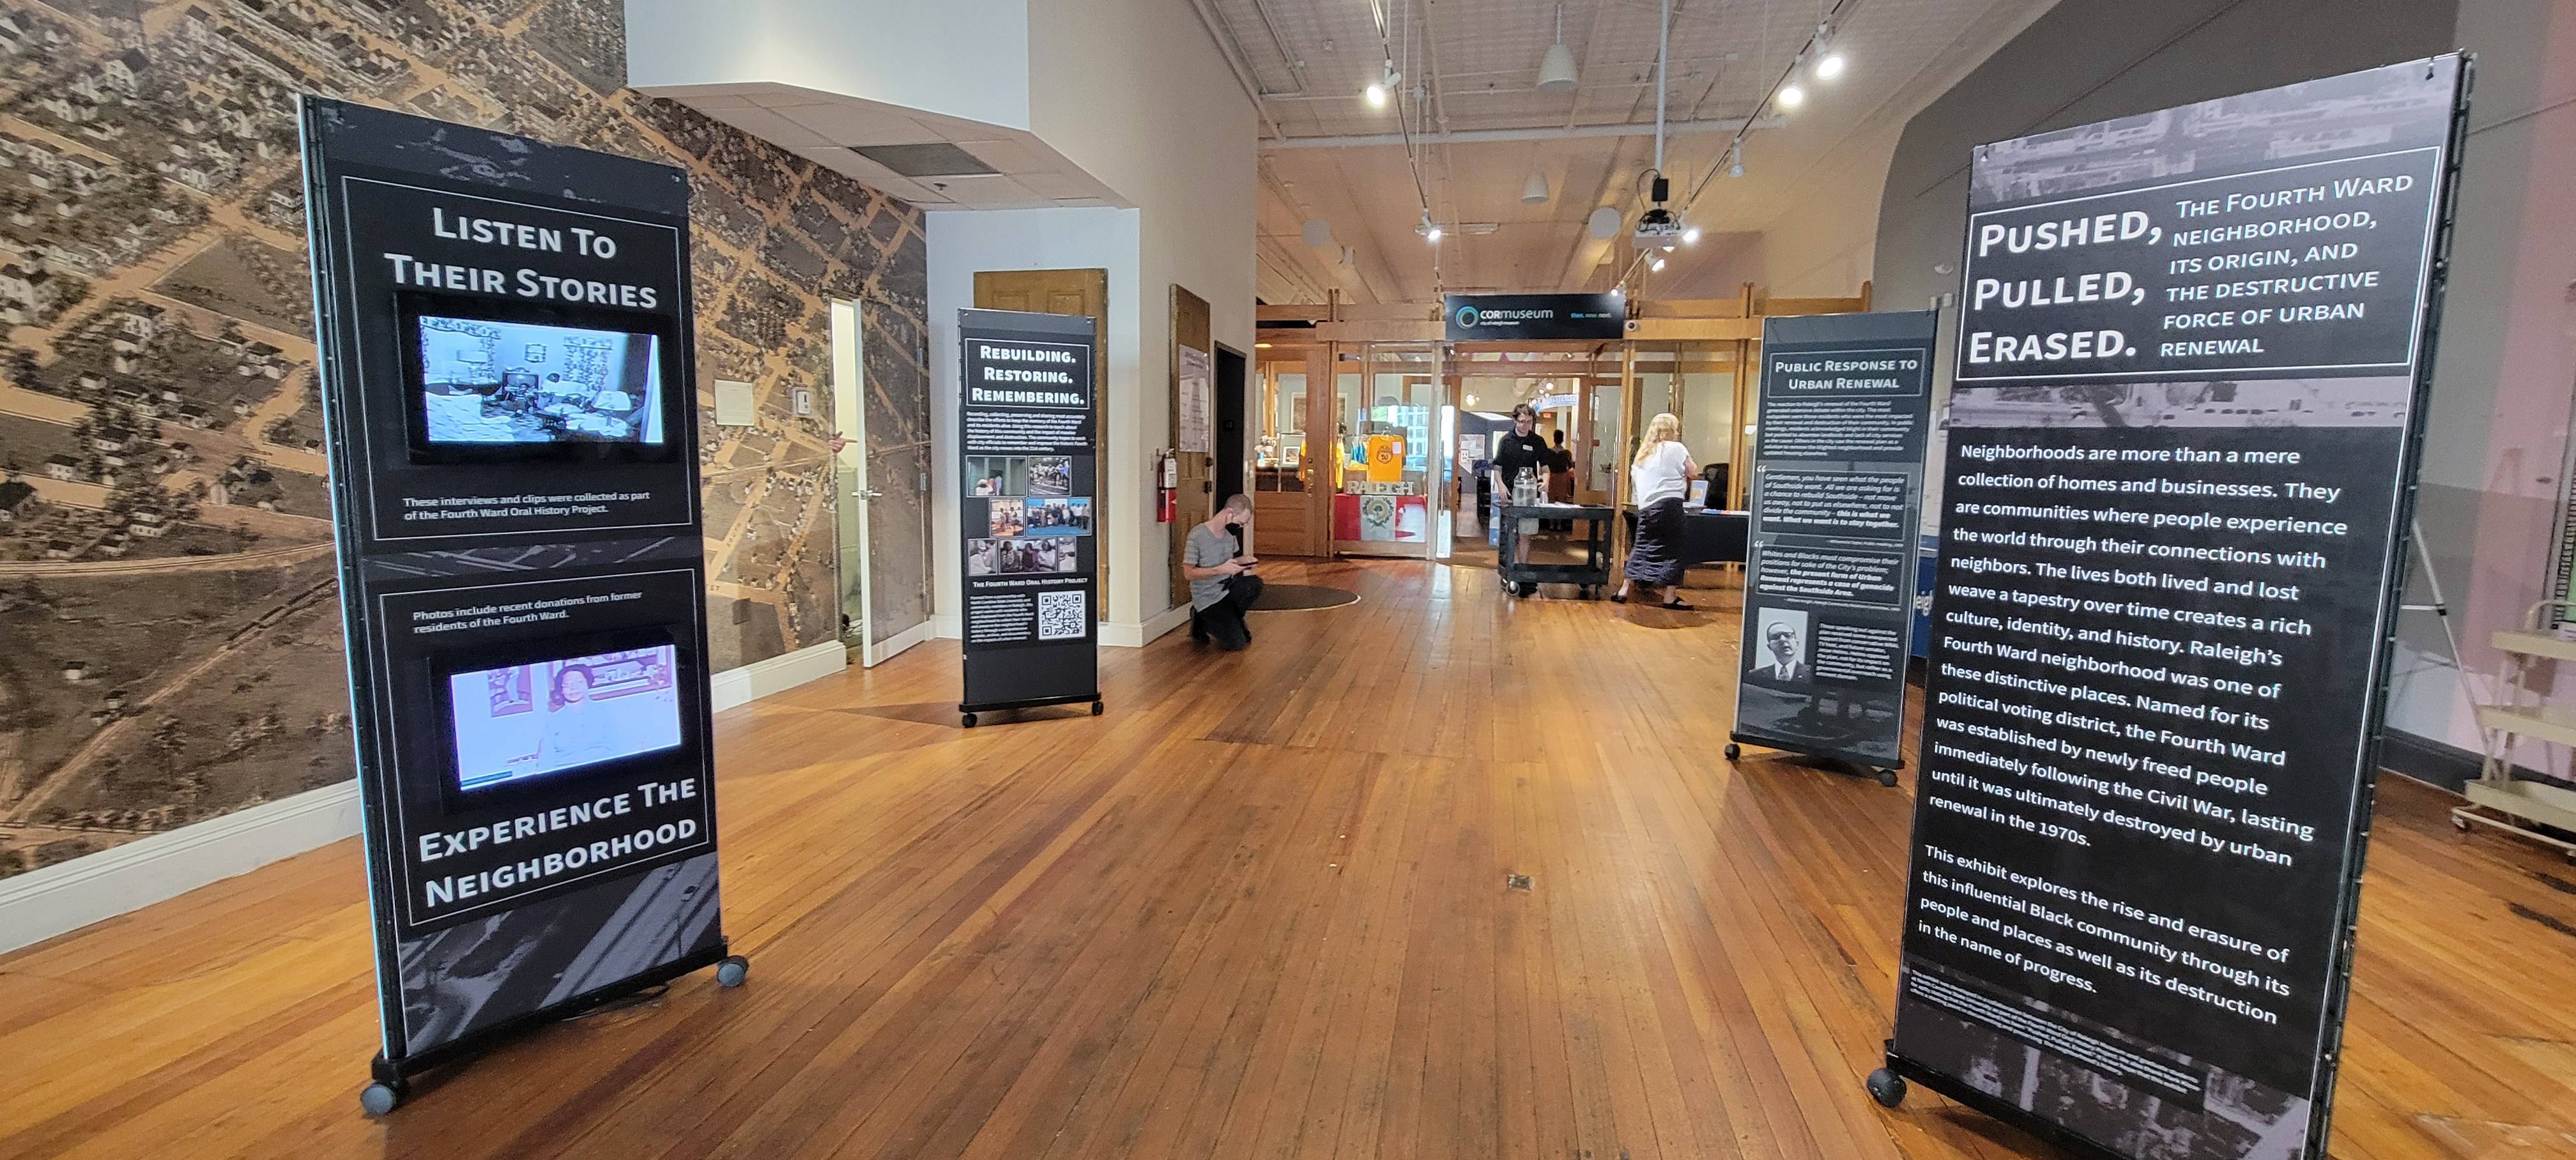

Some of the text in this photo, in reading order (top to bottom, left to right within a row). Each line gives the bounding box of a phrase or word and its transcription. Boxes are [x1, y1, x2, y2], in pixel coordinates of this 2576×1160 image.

[2176, 176, 2413, 218] THE FOURTH WARD
[433, 208, 616, 258] LISTEN TO
[1979, 211, 2161, 256] PUSHED,
[2174, 211, 2376, 247] NEIGHBORHOOD,
[2170, 243, 2358, 274] ITS ORIGIN, AND
[384, 253, 656, 308] THEIR STORIES
[1975, 271, 2145, 310] PULLED,
[2166, 271, 2379, 301] THE DESTRUCTIVE
[2164, 303, 2364, 329] FORCE OF URBAN
[981, 346, 1076, 363] REBUILDING.
[1969, 330, 2136, 363] ERASED.
[2161, 339, 2264, 356] RENEWAL
[985, 367, 1073, 383] RESTORING.
[1775, 360, 1917, 372] PUBLIC RESPONSE TO
[972, 388, 1084, 404] REMEMBERING.
[1789, 378, 1899, 389] URBAN RENEWAL
[1961, 445, 2300, 464] Neighborhoods are more than a mere
[403, 498, 439, 507] These
[440, 496, 498, 505] interviews
[500, 495, 521, 503] and
[522, 495, 547, 505] clips
[574, 492, 617, 501] collected
[631, 492, 650, 501] part
[1959, 473, 2341, 503] collection of homes and businesses. They
[404, 505, 609, 520] of the Fourth Ward Oral History Project.
[1956, 503, 2347, 535] are communities where people experience
[1953, 528, 2326, 568] the world through their connections with
[1951, 556, 2299, 600] neighbors. The lives both lived and lost
[413, 611, 454, 620] Photos
[455, 605, 498, 616] include
[499, 602, 533, 612] recent
[534, 598, 585, 608] donations
[611, 592, 642, 600] former
[413, 610, 569, 633] residents of the Fourth Ward.
[1949, 585, 2311, 636] weave a tapestry over time creates a rich
[1946, 611, 2282, 666] culture, identity, and history. Raleigh’s
[419, 778, 696, 862] EXPERIENCE THE
[1930, 797, 2090, 846] renewal in the 1970s.
[426, 820, 696, 907] NEIGHBORHOOD
[1926, 845, 2290, 963] This exhibit explores the rise and erasure of
[1919, 920, 2096, 993] in the name of progress.
